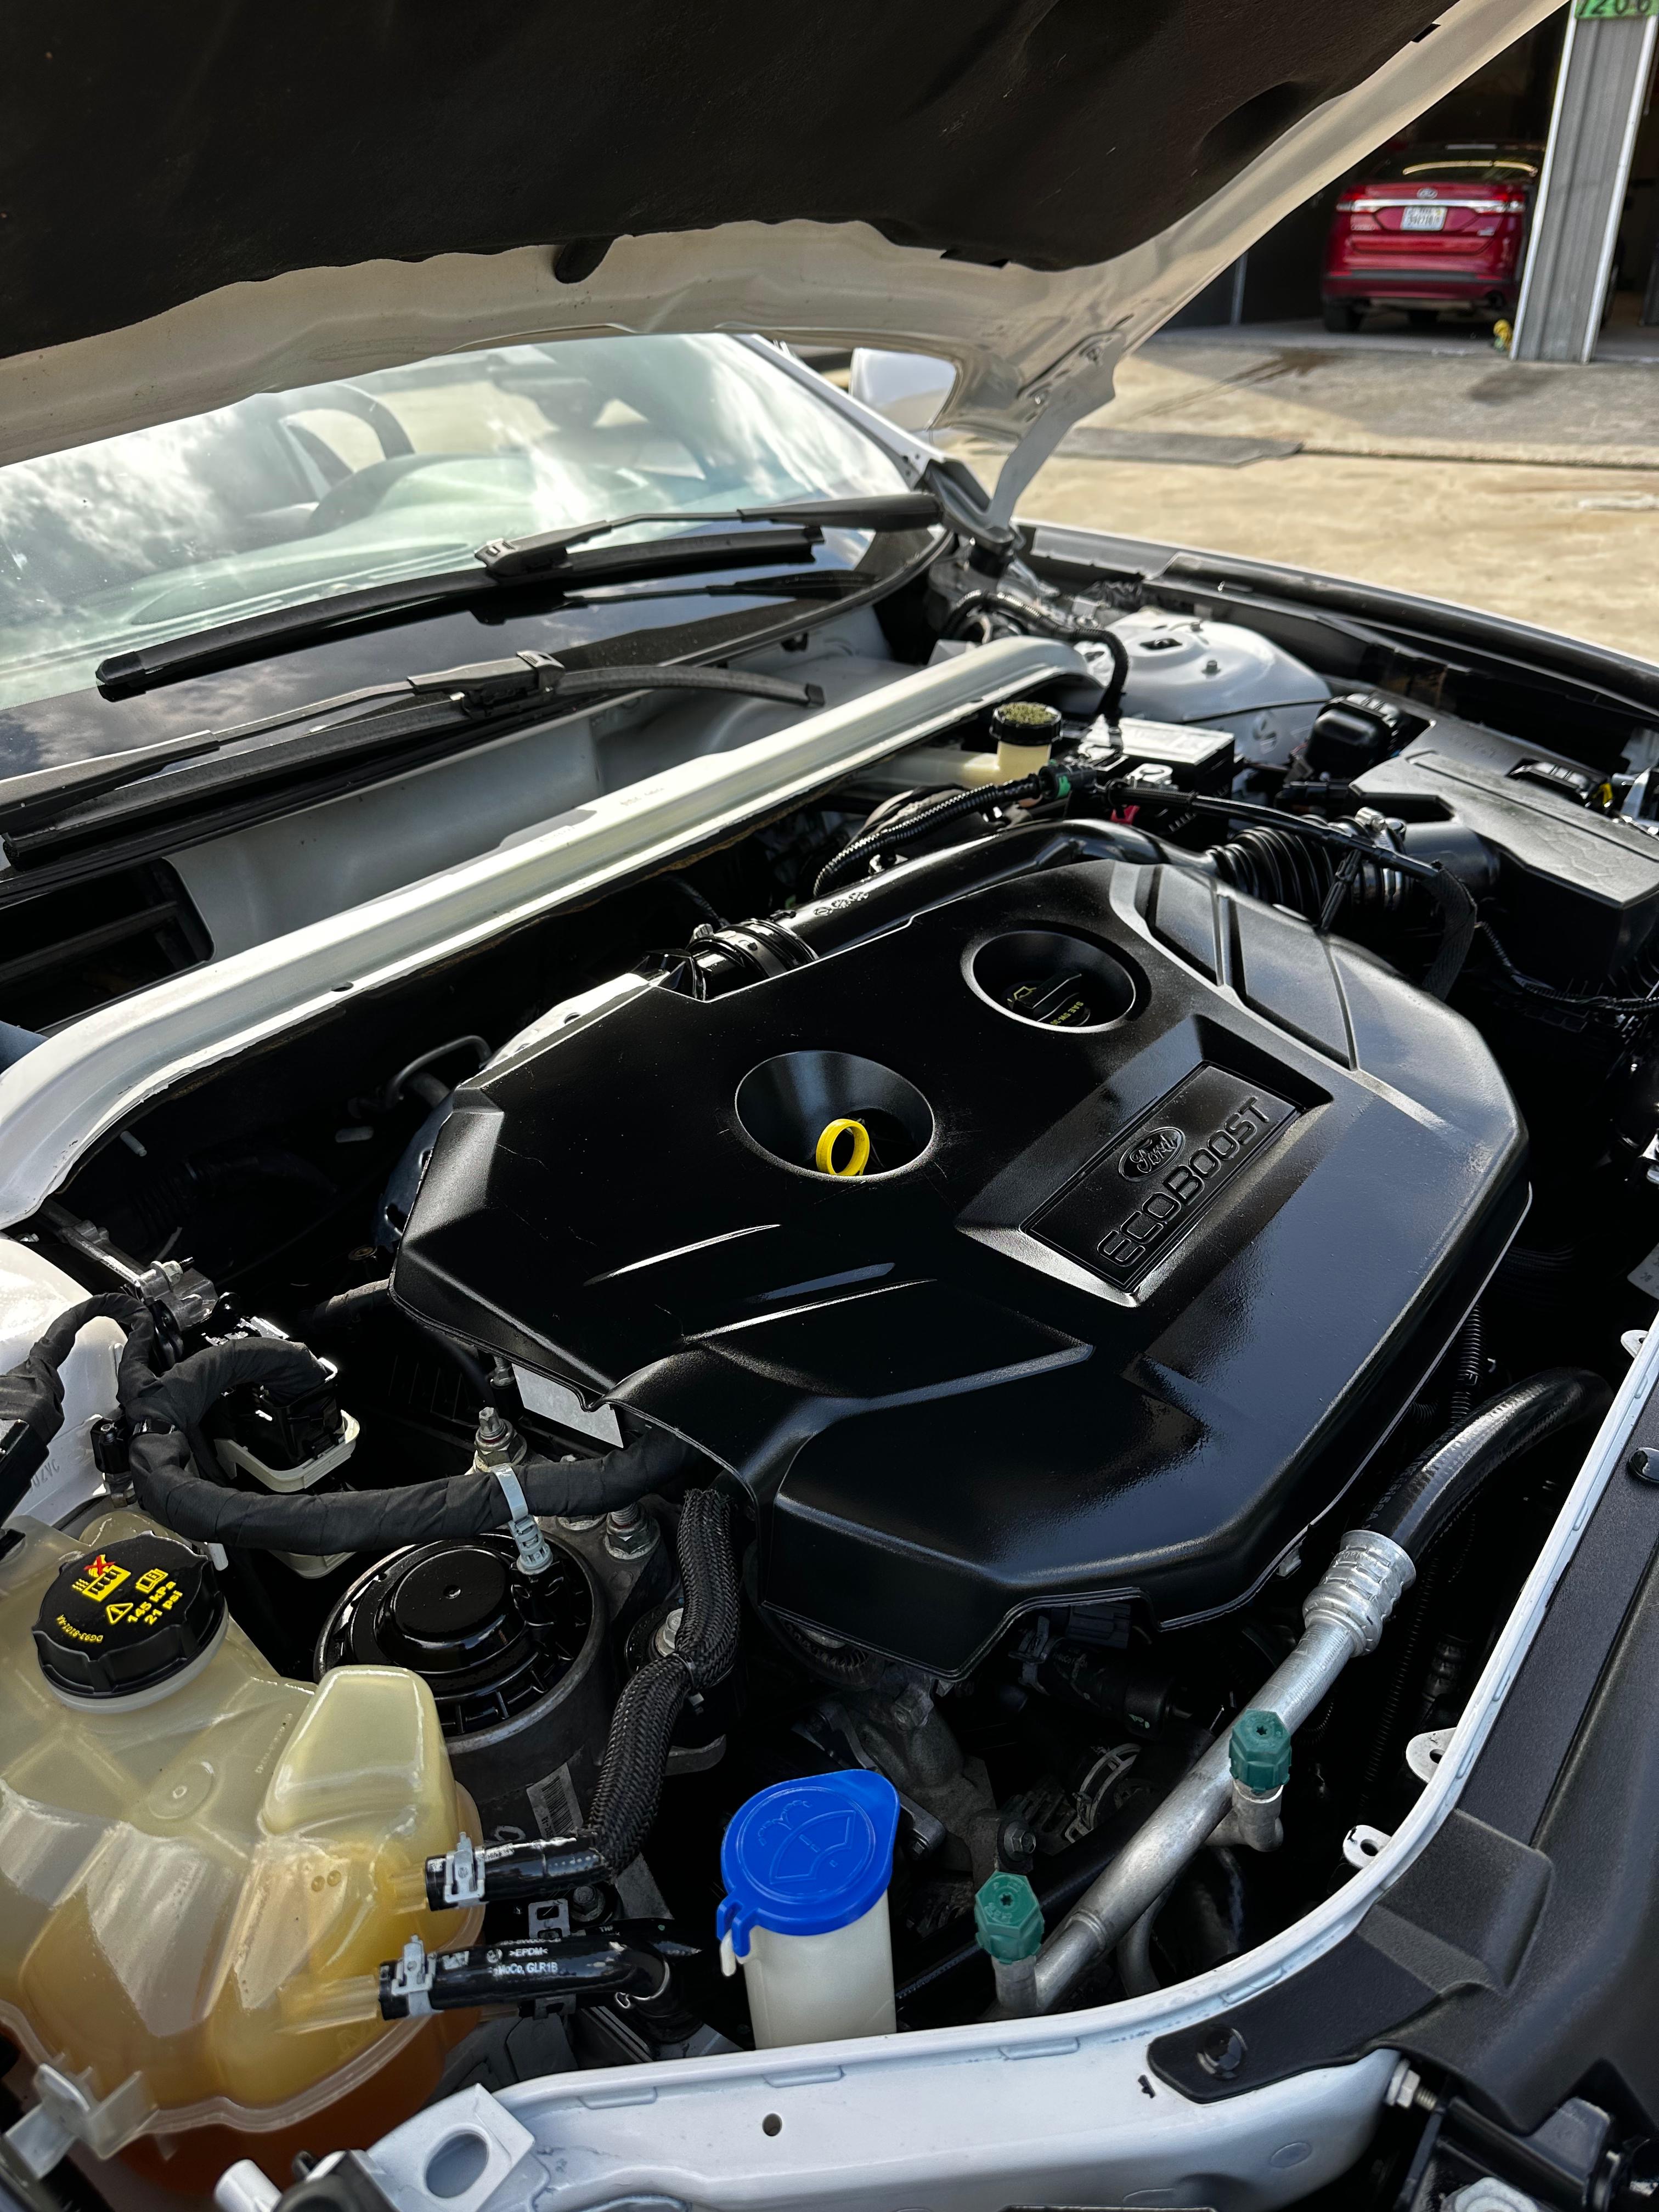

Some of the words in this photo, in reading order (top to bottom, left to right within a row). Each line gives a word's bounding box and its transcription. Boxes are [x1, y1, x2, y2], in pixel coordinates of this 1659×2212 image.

[1129, 1133, 1176, 1173] Ford
[1097, 1096, 1269, 1267] ECOBOOST
[127, 1601, 152, 1623] 145
[149, 1581, 176, 1603] kPa
[143, 1609, 163, 1625] 21
[162, 1590, 183, 1610] psi
